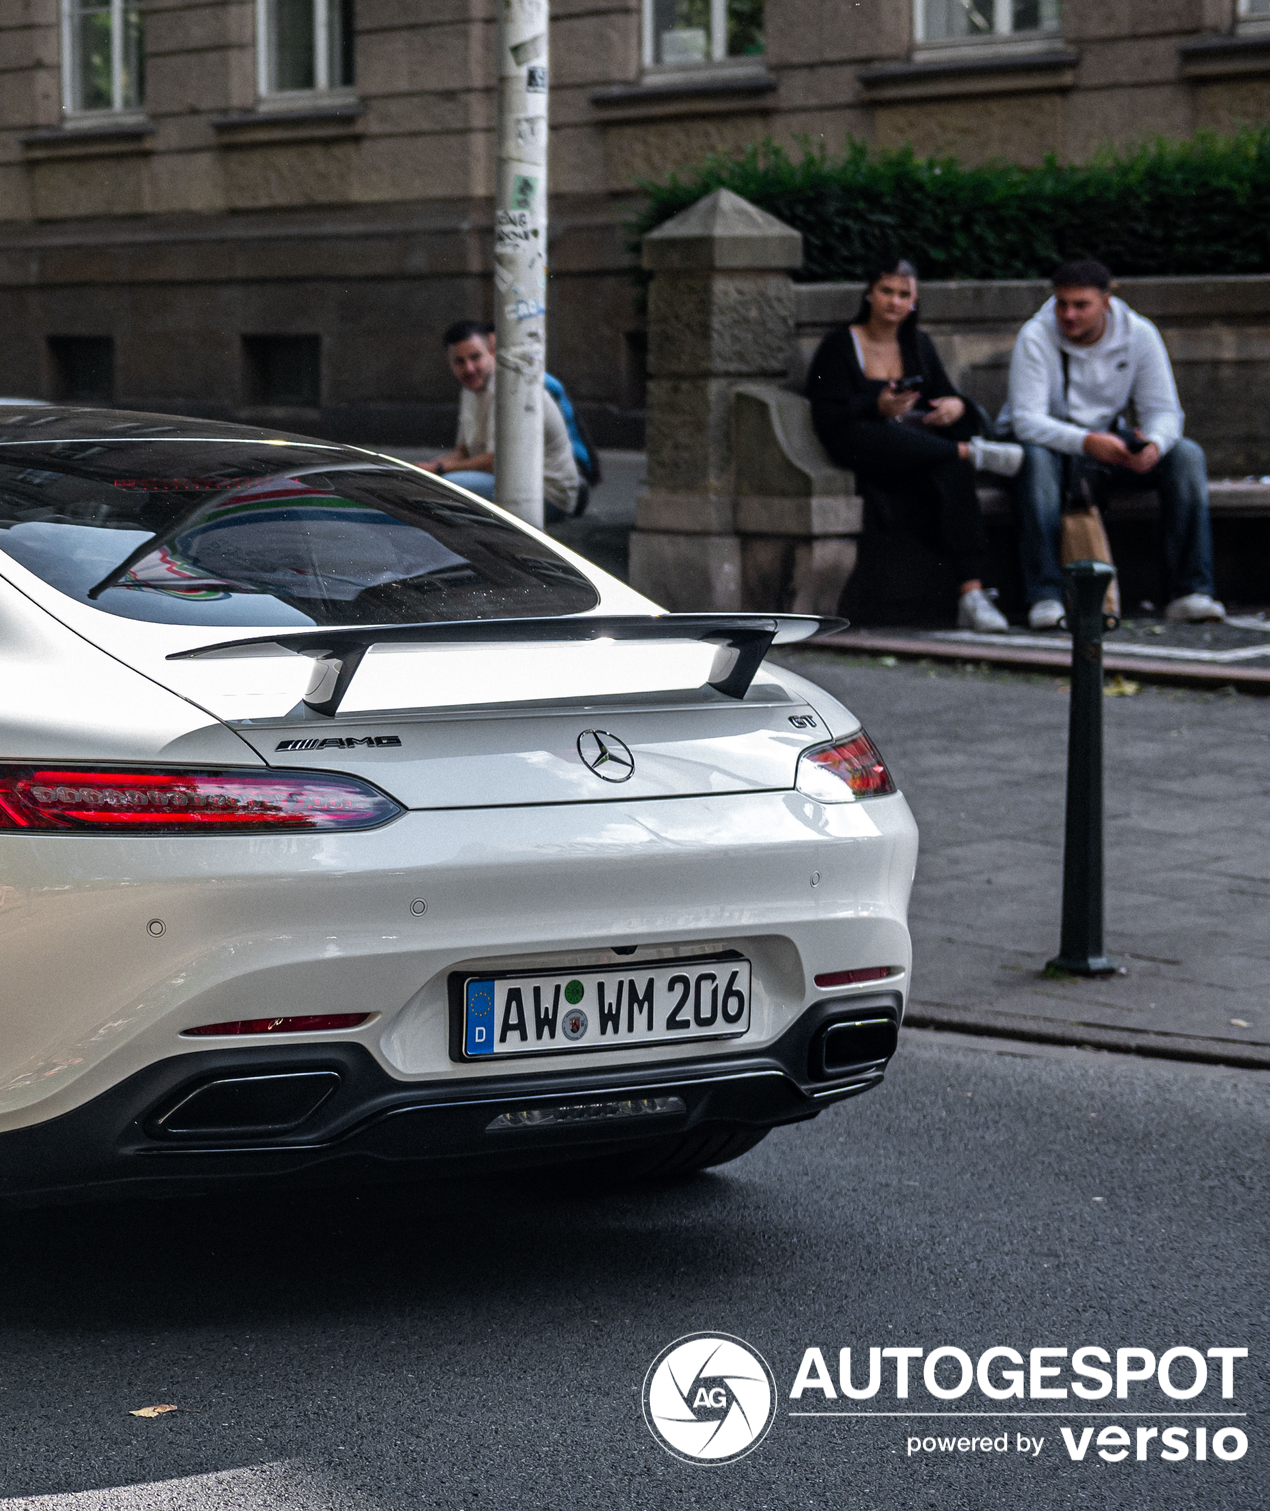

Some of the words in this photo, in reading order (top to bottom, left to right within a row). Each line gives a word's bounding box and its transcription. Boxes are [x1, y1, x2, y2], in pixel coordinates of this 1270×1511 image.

[788, 715, 817, 729] GT
[498, 983, 562, 1043] AW
[596, 976, 655, 1036] WM
[665, 968, 746, 1031] 206
[474, 1026, 486, 1043] D
